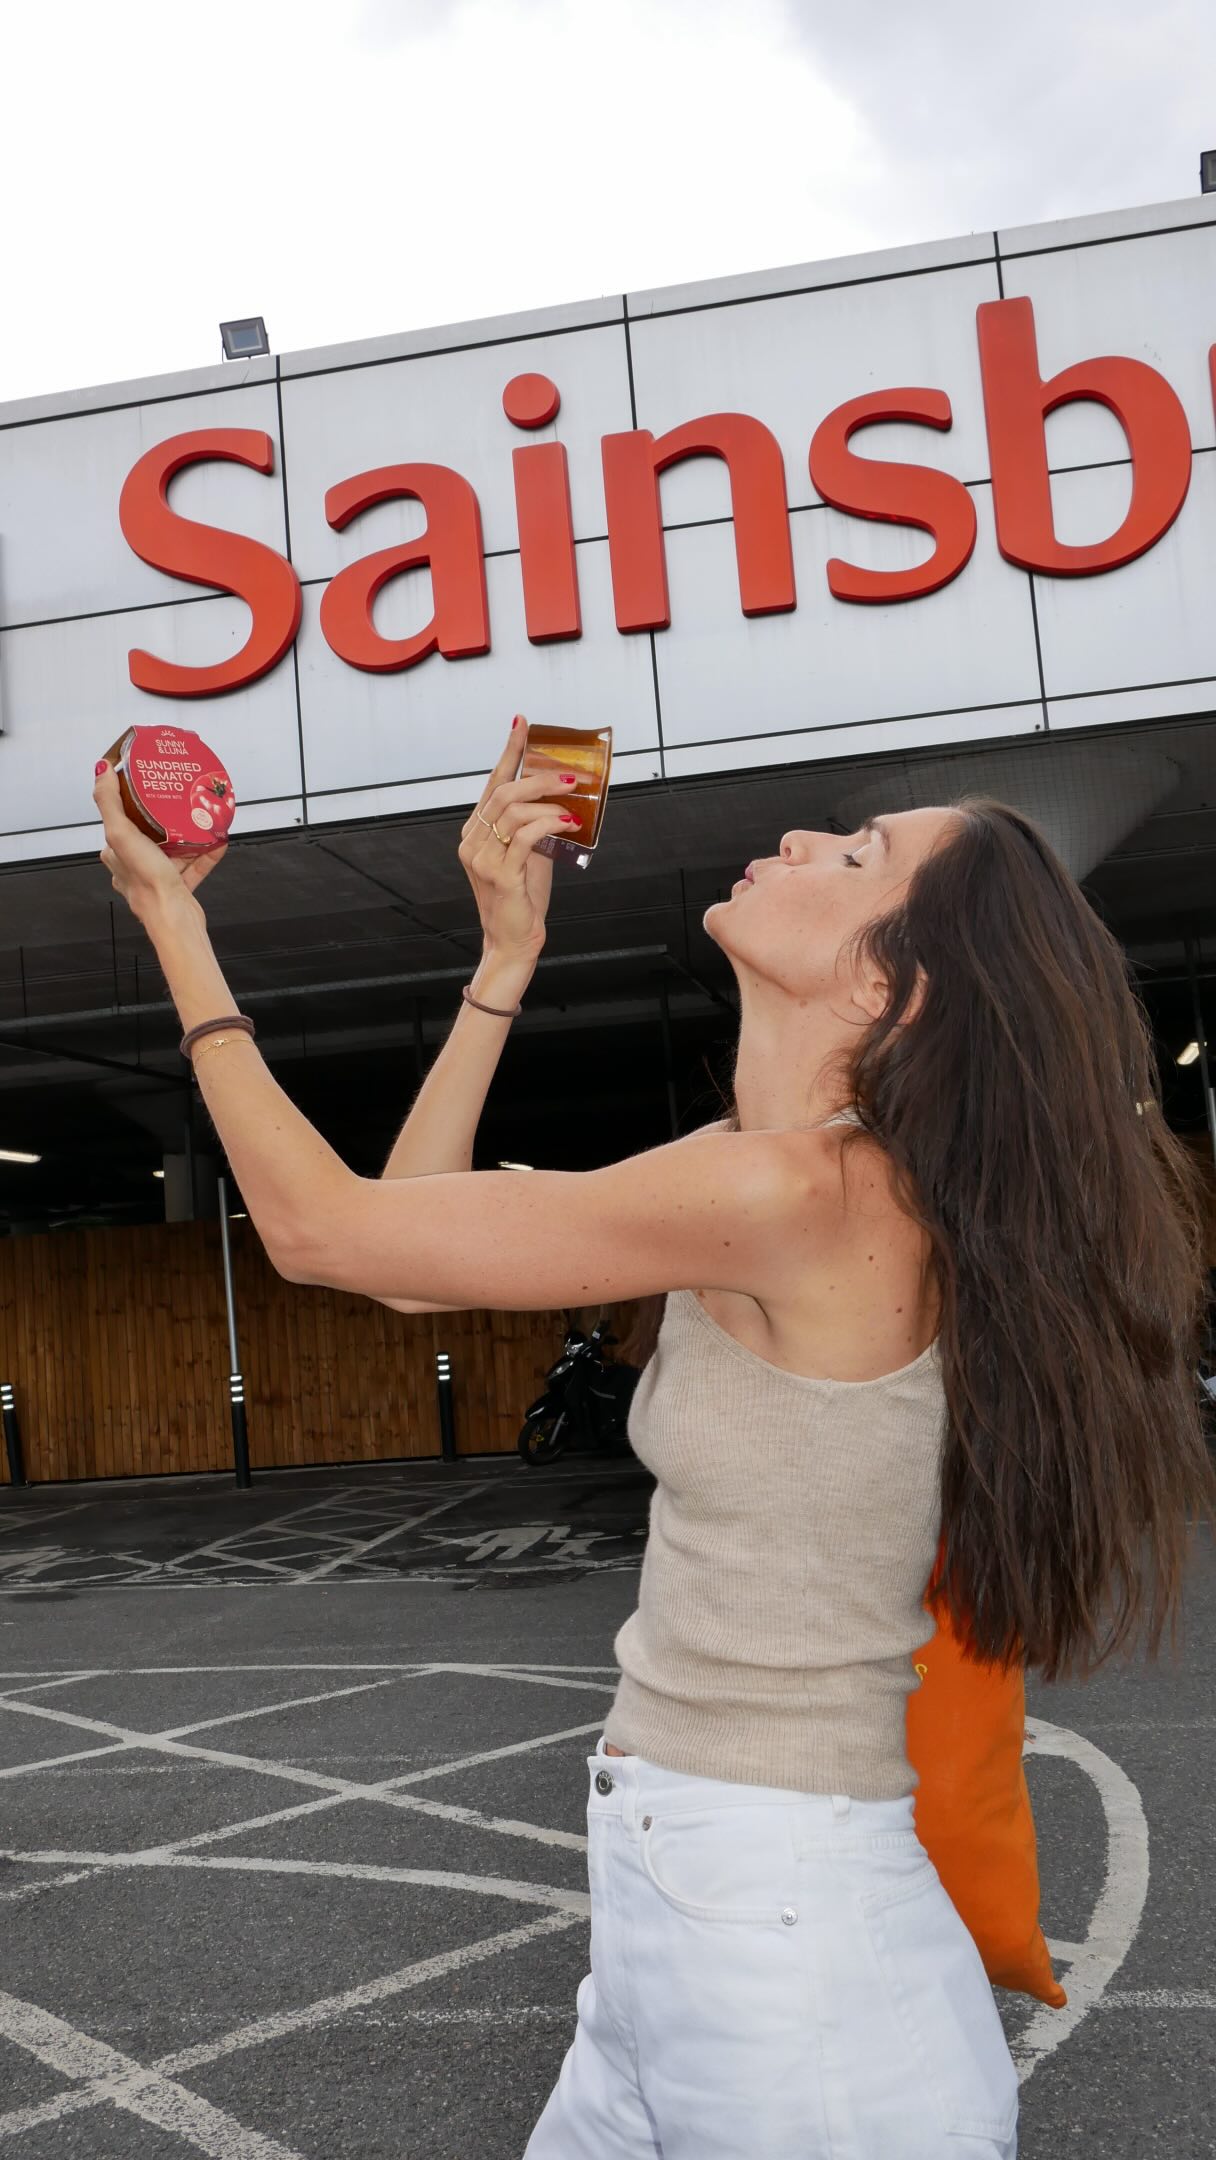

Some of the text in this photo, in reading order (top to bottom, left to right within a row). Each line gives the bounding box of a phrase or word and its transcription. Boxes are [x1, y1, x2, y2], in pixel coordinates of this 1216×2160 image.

[119, 296, 1216, 698] Sainsb
[155, 739, 185, 748] SUNNY
[136, 759, 202, 772] SUNDRIED
[138, 769, 193, 782] TOMATO
[142, 780, 184, 792] PESTO
